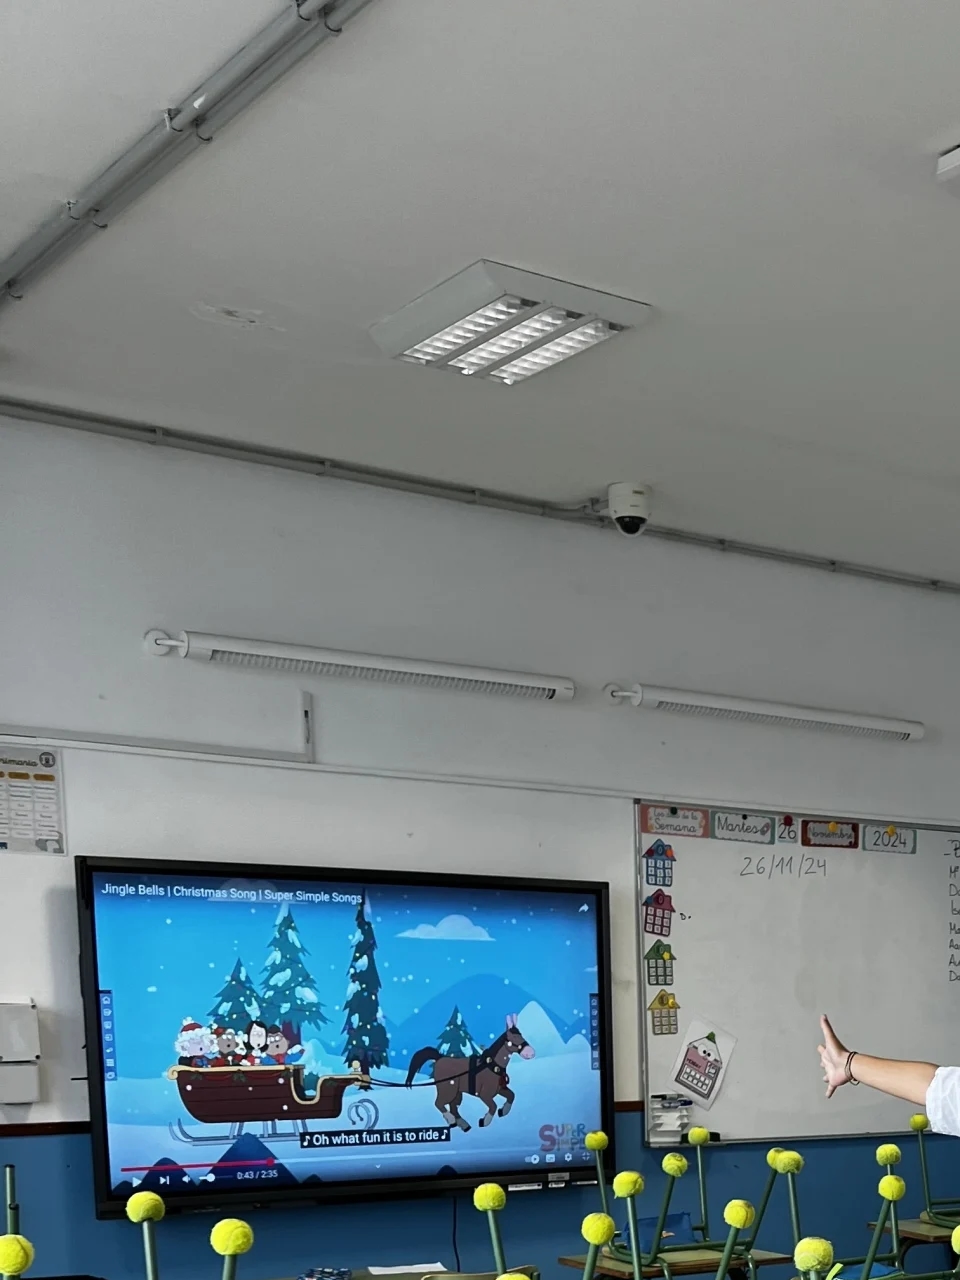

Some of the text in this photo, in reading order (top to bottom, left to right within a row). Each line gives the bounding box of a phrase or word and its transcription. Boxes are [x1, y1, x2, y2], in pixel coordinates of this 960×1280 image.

[654, 818, 697, 833] Semana
[717, 816, 759, 834] Martes
[778, 823, 797, 840] 26
[873, 830, 907, 848] 2024
[740, 854, 827, 879] 26/11/24
[102, 883, 362, 904] Jingle Bells Christmas Song Super Simple Songs
[312, 1128, 439, 1146] Oh what fun it is to ride
[237, 1169, 278, 1180] 0:43 2:35
